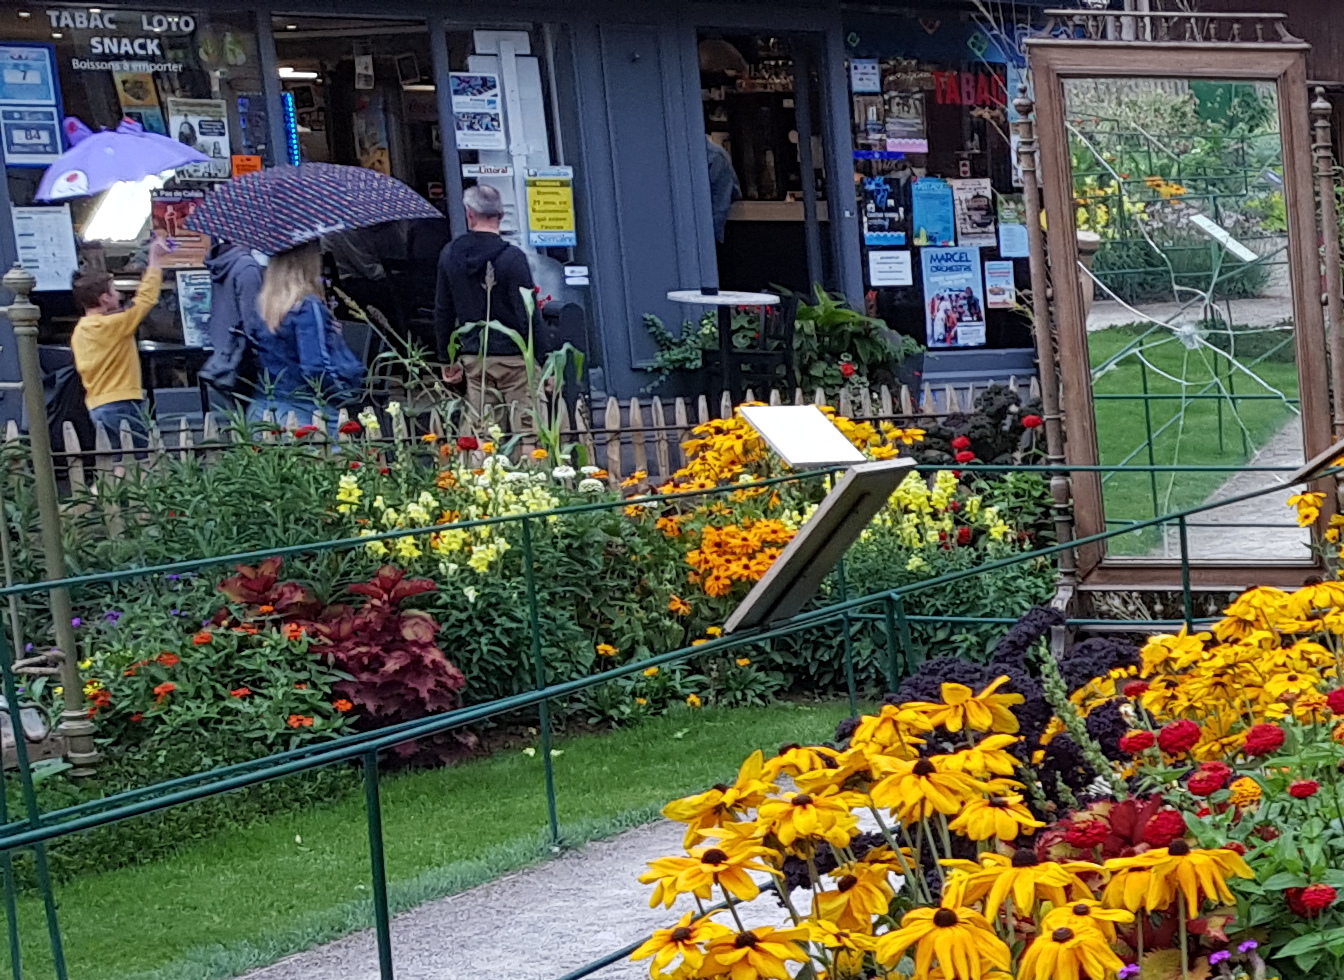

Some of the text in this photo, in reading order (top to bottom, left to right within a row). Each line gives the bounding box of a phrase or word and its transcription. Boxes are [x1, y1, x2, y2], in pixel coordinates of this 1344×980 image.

[49, 11, 196, 33] TABAC LOTO
[90, 36, 162, 56] SNACK
[72, 58, 120, 71] Boissons
[131, 61, 183, 74] emporter
[931, 70, 1006, 105] TABAC
[930, 252, 972, 264] MARCEL
